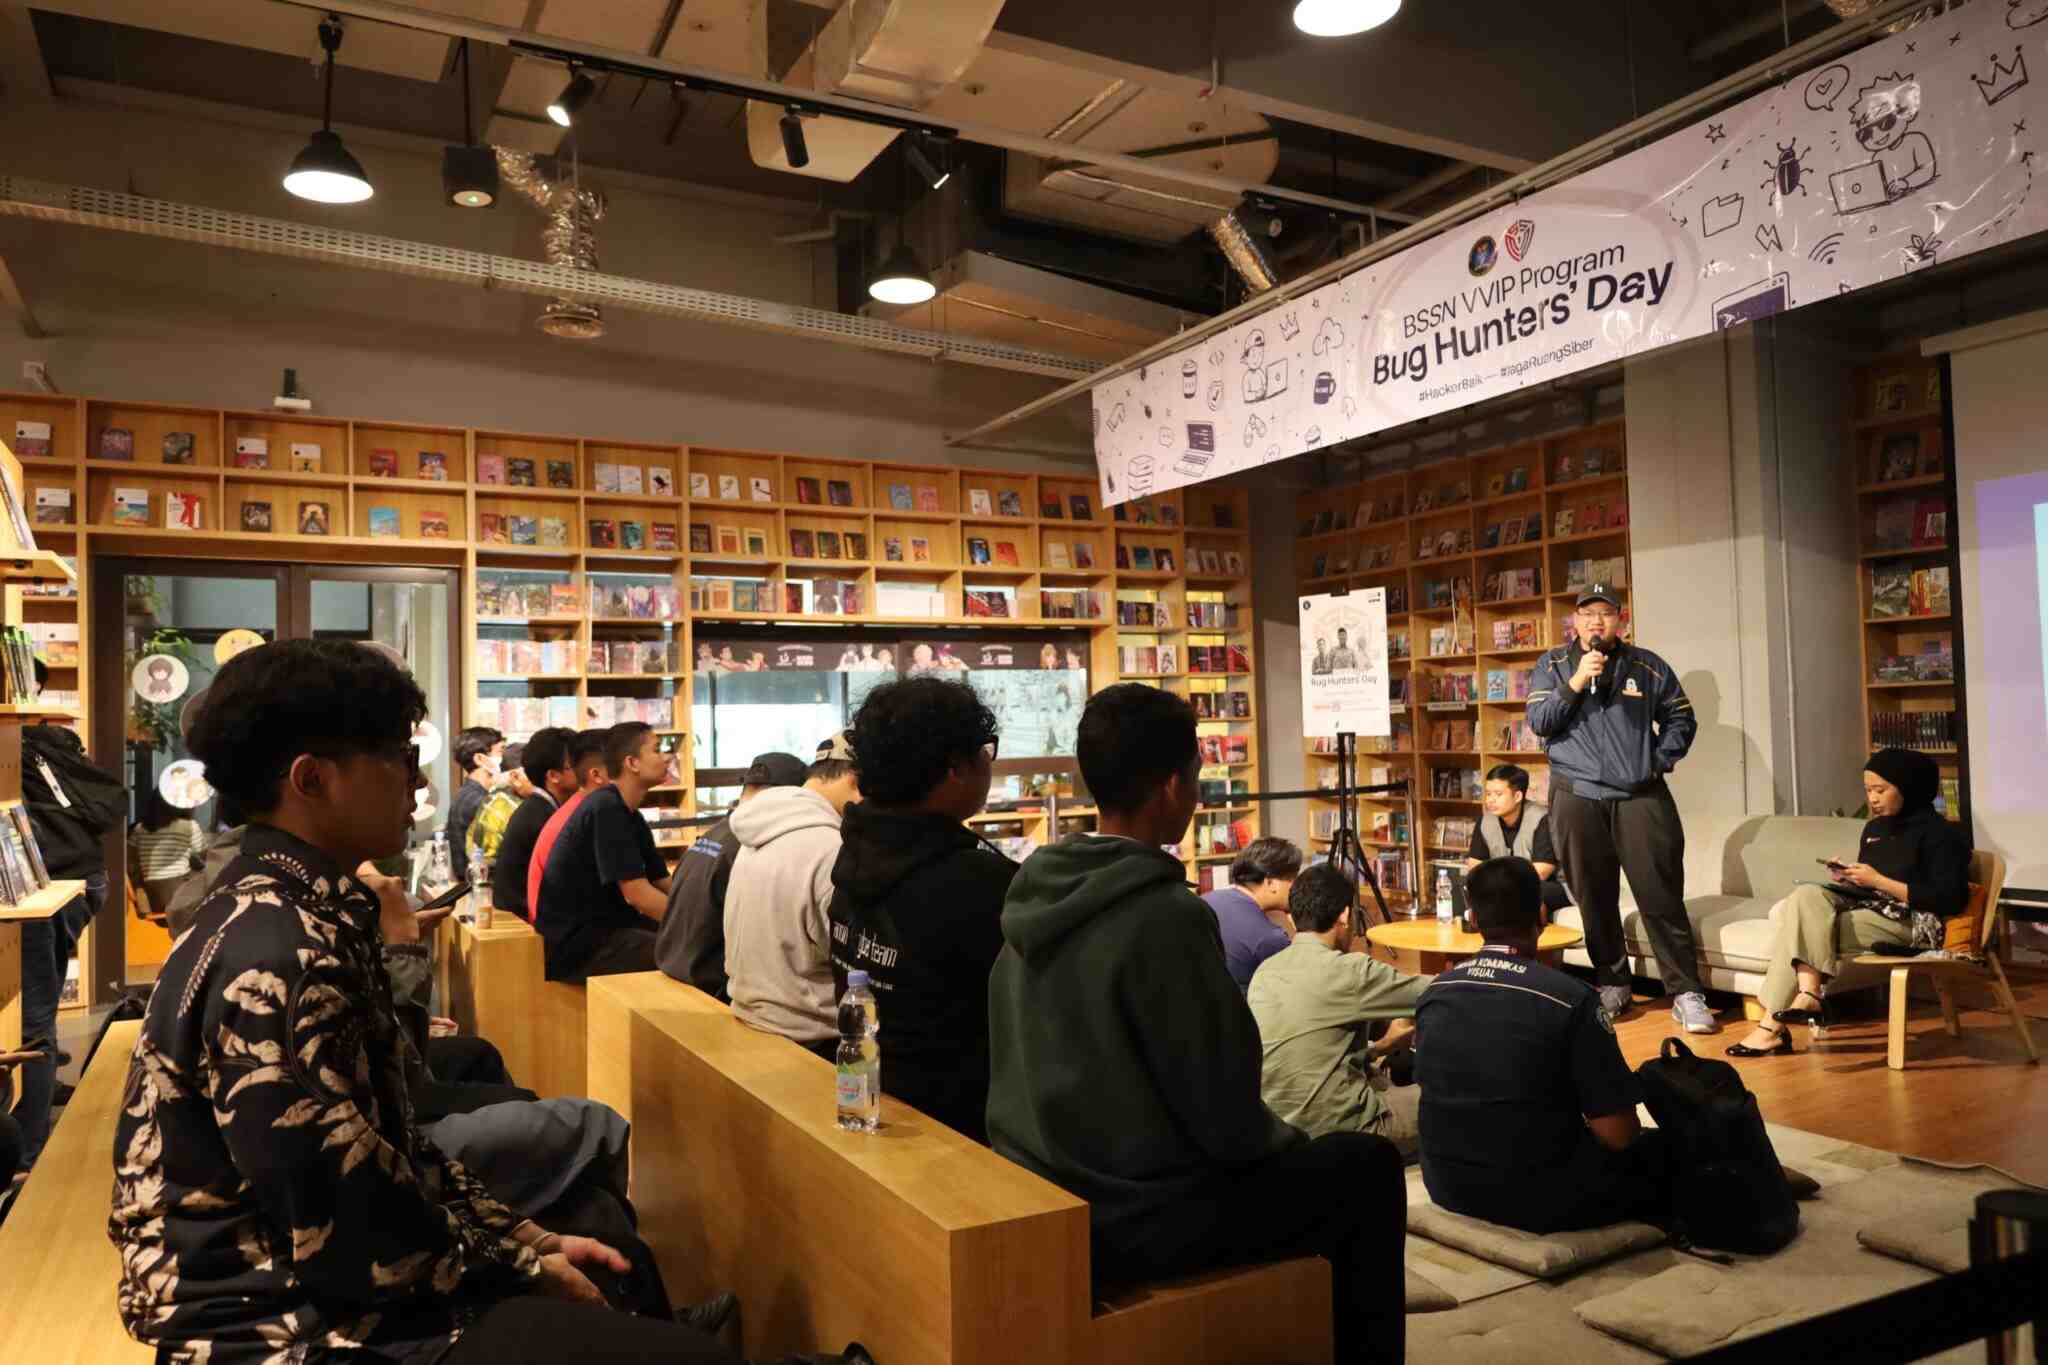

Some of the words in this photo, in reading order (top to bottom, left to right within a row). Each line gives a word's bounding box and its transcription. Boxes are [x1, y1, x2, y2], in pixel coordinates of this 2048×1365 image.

[1373, 341, 1428, 384] Bug
[1587, 261, 1673, 312] Day
[1403, 304, 1457, 338] BSSN
[1462, 275, 1514, 313] VVIP
[1520, 244, 1624, 293] Program
[1467, 967, 1495, 978] VISUAL
